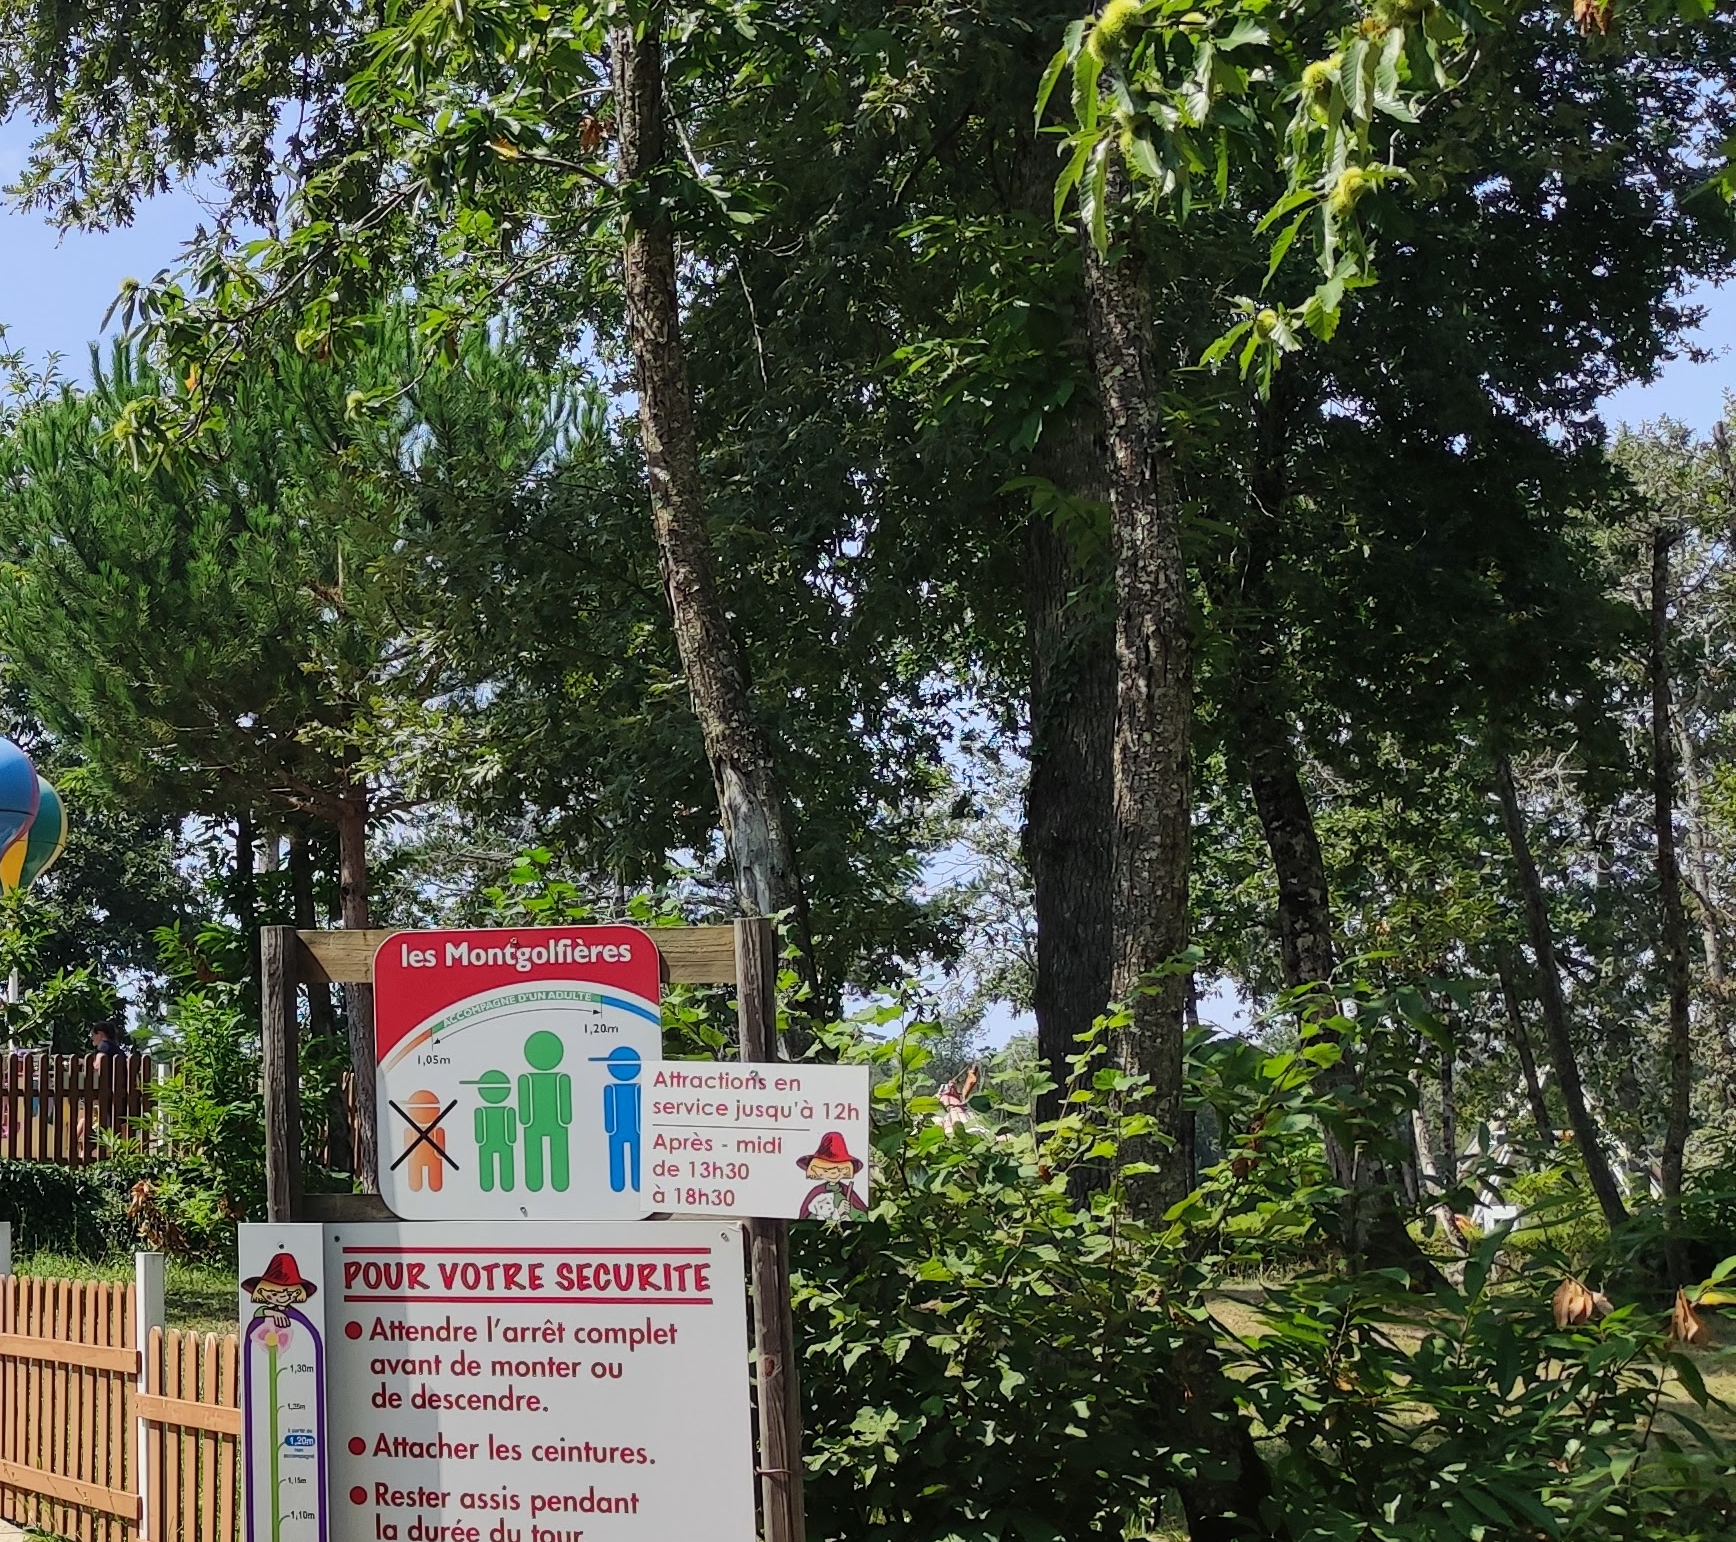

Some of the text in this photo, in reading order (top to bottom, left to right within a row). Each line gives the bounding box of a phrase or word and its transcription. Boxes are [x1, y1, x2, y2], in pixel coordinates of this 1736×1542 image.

[401, 938, 632, 972] les Montgolfières
[518, 991, 546, 1003] D'UN
[547, 991, 592, 1002] ADULTE
[584, 1023, 619, 1034] 1,20m
[417, 1055, 451, 1065] 1,05m
[653, 1070, 801, 1092] Attractions en
[652, 1098, 860, 1122] service jusqu'à 12h
[652, 1132, 713, 1154] Après
[736, 1136, 782, 1154] midi
[652, 1160, 750, 1180] de 13h30
[652, 1184, 735, 1206] à 18h30
[344, 1262, 712, 1292] POUR VOTRE SECURITE
[369, 1316, 678, 1352] Attendre l'arrêt complet
[370, 1349, 623, 1379] avant de monter ou
[371, 1382, 549, 1412] de descendre.
[372, 1432, 656, 1465] Attacher les ceintures.
[374, 1481, 639, 1519] Rester assis pendant
[376, 1513, 398, 1541] la
[408, 1515, 481, 1542] durée
